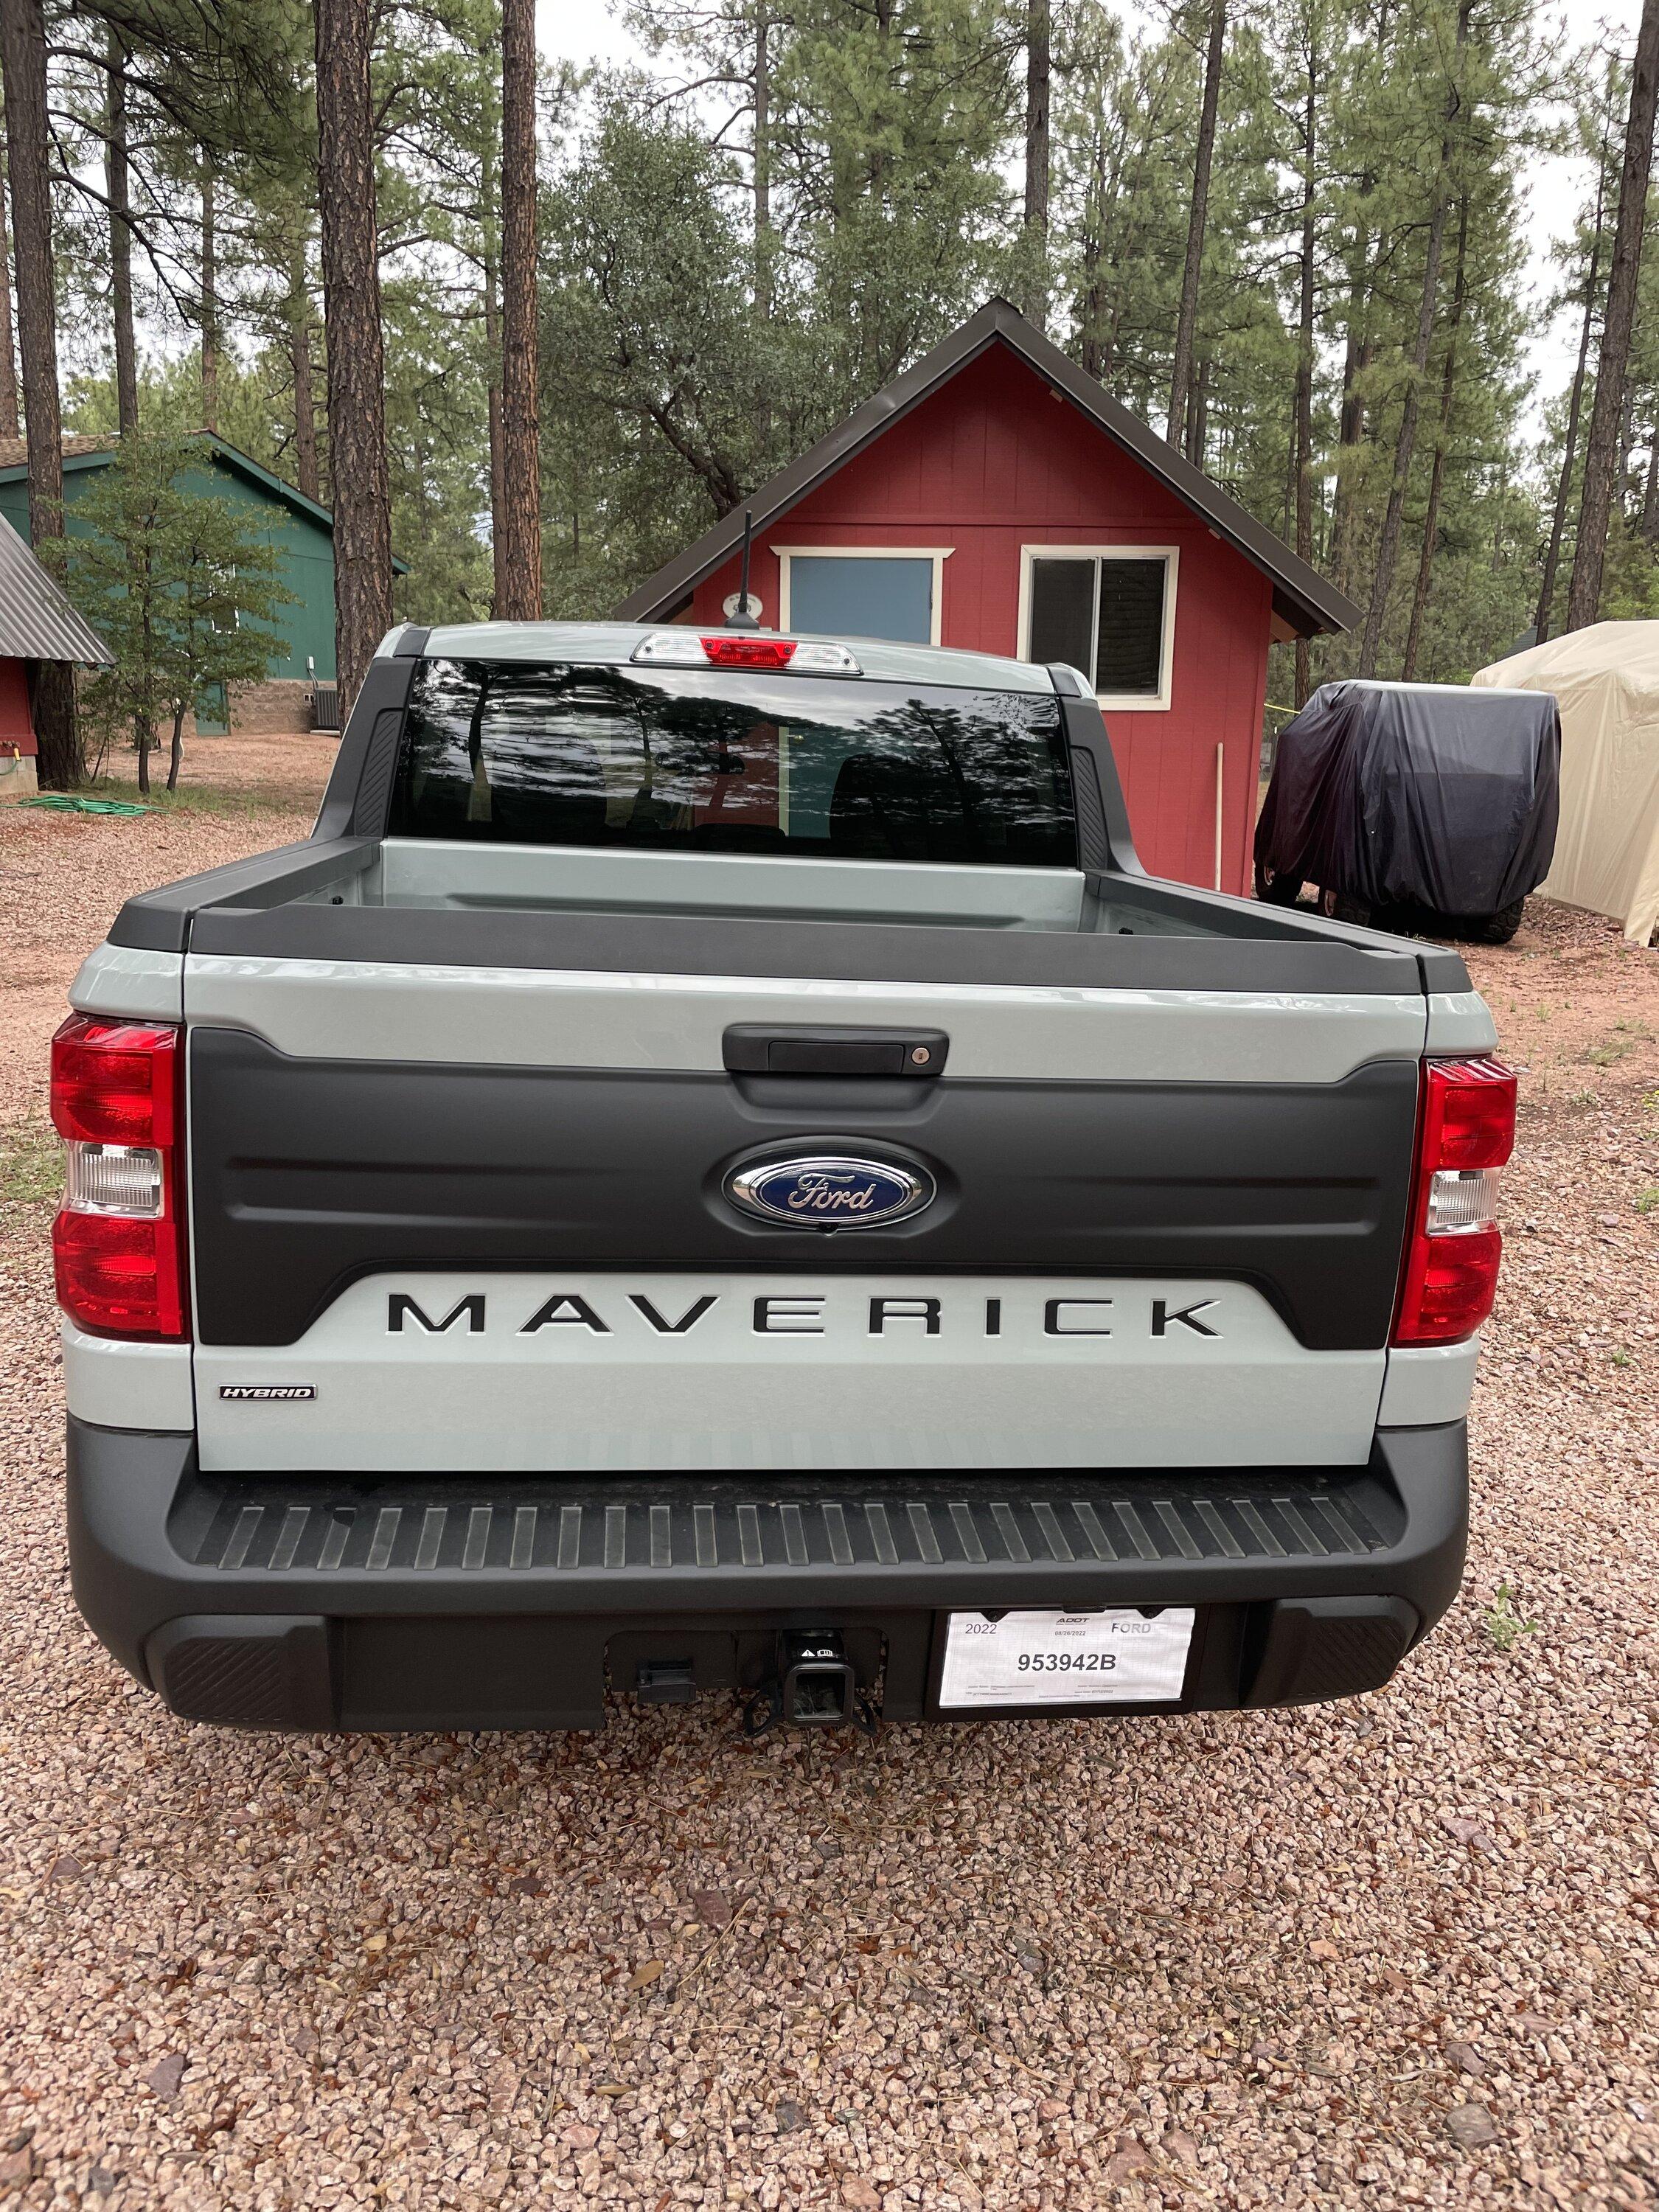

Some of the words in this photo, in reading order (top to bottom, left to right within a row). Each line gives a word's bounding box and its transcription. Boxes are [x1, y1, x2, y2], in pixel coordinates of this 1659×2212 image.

[787, 1172, 877, 1209] Ford
[386, 1293, 1223, 1339] MAVERICK
[223, 1388, 312, 1398] HYBRID
[965, 1624, 997, 1634] 2022
[1111, 1623, 1151, 1633] FORD
[1018, 1653, 1116, 1671] 953942B
